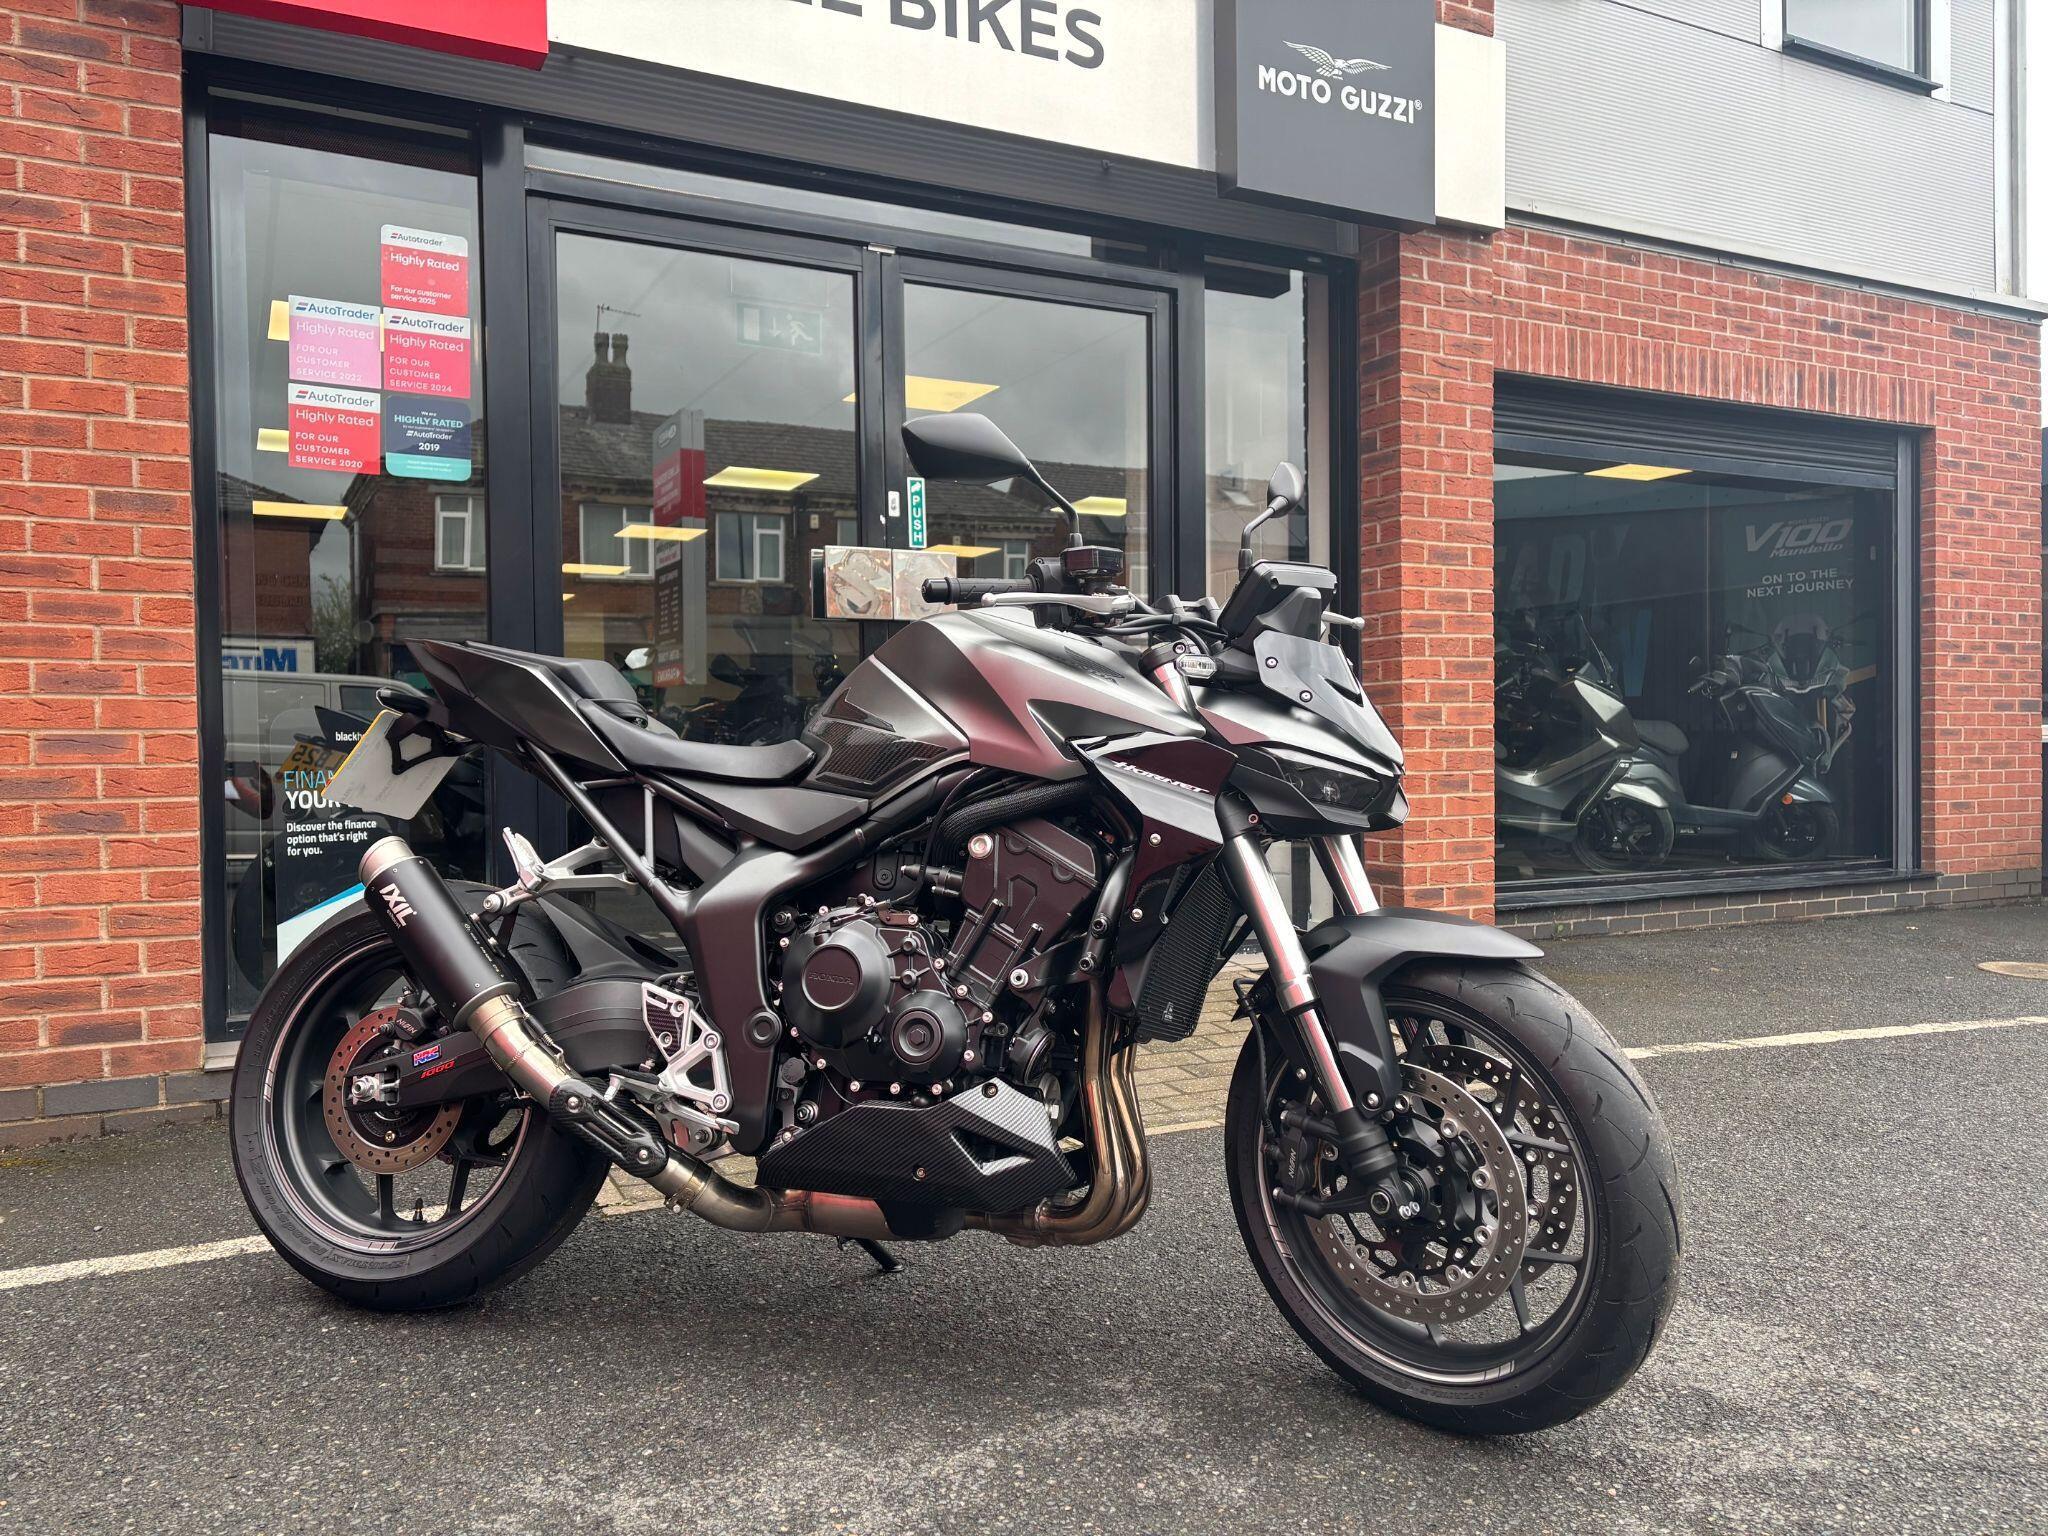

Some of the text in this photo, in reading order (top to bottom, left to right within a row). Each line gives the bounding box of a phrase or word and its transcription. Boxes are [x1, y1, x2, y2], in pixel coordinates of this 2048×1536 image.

[1258, 64, 1414, 124] MOTO GUZZI
[398, 233, 443, 248] Autotrader
[390, 252, 460, 271] Highly Rated
[390, 284, 452, 300] For our customer
[390, 293, 436, 305] service 2025
[308, 303, 375, 320] AutoTrader
[296, 321, 375, 340] Highly Rated
[401, 316, 464, 333] AutoTrader
[296, 343, 338, 356] FOR OUR
[390, 334, 465, 352] Highly Rated
[296, 355, 350, 369] CUSTOMER
[389, 356, 430, 367] FOR OUR
[296, 367, 337, 379] SERVICE
[389, 367, 441, 380] CUSTOMER
[389, 379, 452, 392] SERVICE 2024
[308, 391, 375, 407] AutoTrader
[295, 409, 374, 427] Highly Rated
[394, 414, 464, 428] HIGHLY RATED
[295, 431, 339, 443] FOR OUR
[413, 430, 453, 441] AutoTrader
[295, 443, 350, 456] CUSTOMER
[418, 442, 440, 452] 2019
[295, 455, 363, 468] SERVICE 2020
[912, 495, 922, 542] PUSH
[1745, 518, 1854, 552] V100
[1768, 543, 1843, 558] Mandello
[1761, 567, 1838, 585] ON TO THE
[1746, 578, 1855, 598] NEXT JOURNEY
[1111, 760, 1210, 793] HORNET
[286, 819, 377, 833] Discover the finance
[286, 830, 368, 846] option that's right
[287, 846, 323, 858] for you.
[379, 883, 414, 927] IXIL
[419, 1059, 456, 1079] 1000
